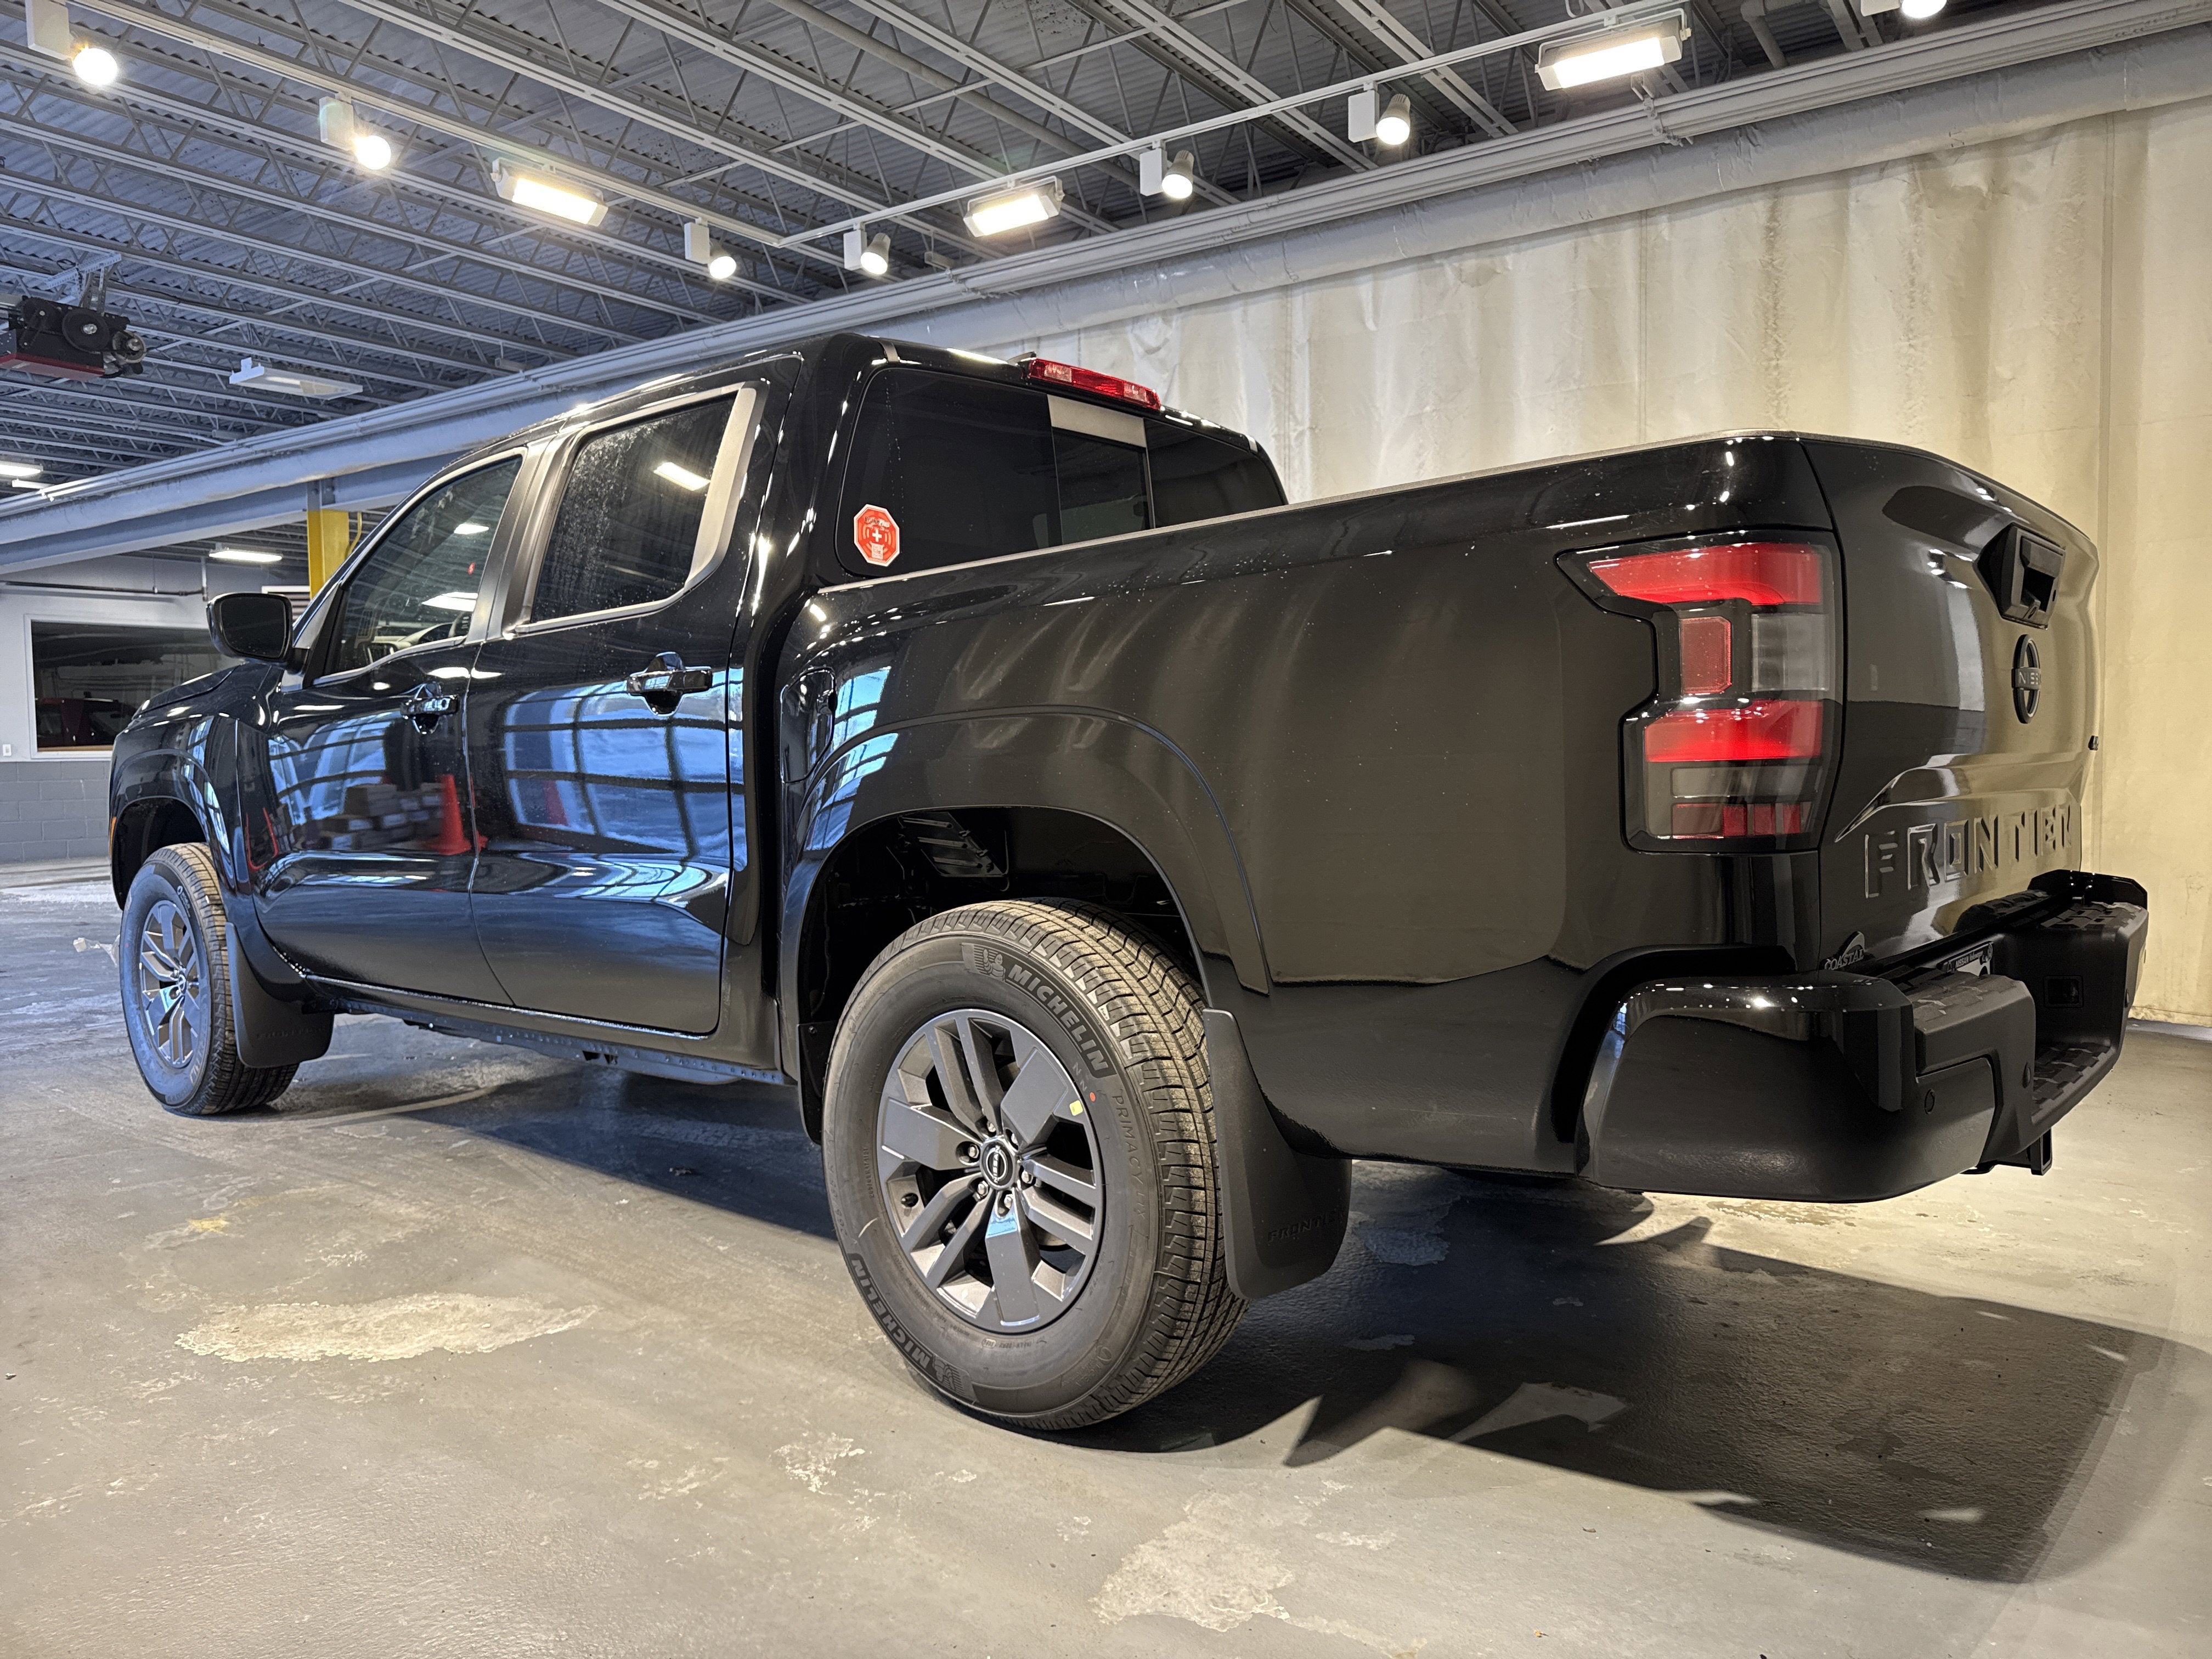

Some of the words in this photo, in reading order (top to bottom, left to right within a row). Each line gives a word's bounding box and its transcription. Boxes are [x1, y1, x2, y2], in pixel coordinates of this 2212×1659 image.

[1864, 804, 2073, 899] FRONTIER
[1824, 949, 1865, 970] COASTAL
[1007, 964, 1109, 1072] MICHELIN
[1111, 1094, 1144, 1186] PRIMACY
[852, 1259, 933, 1369] MICHELIN
